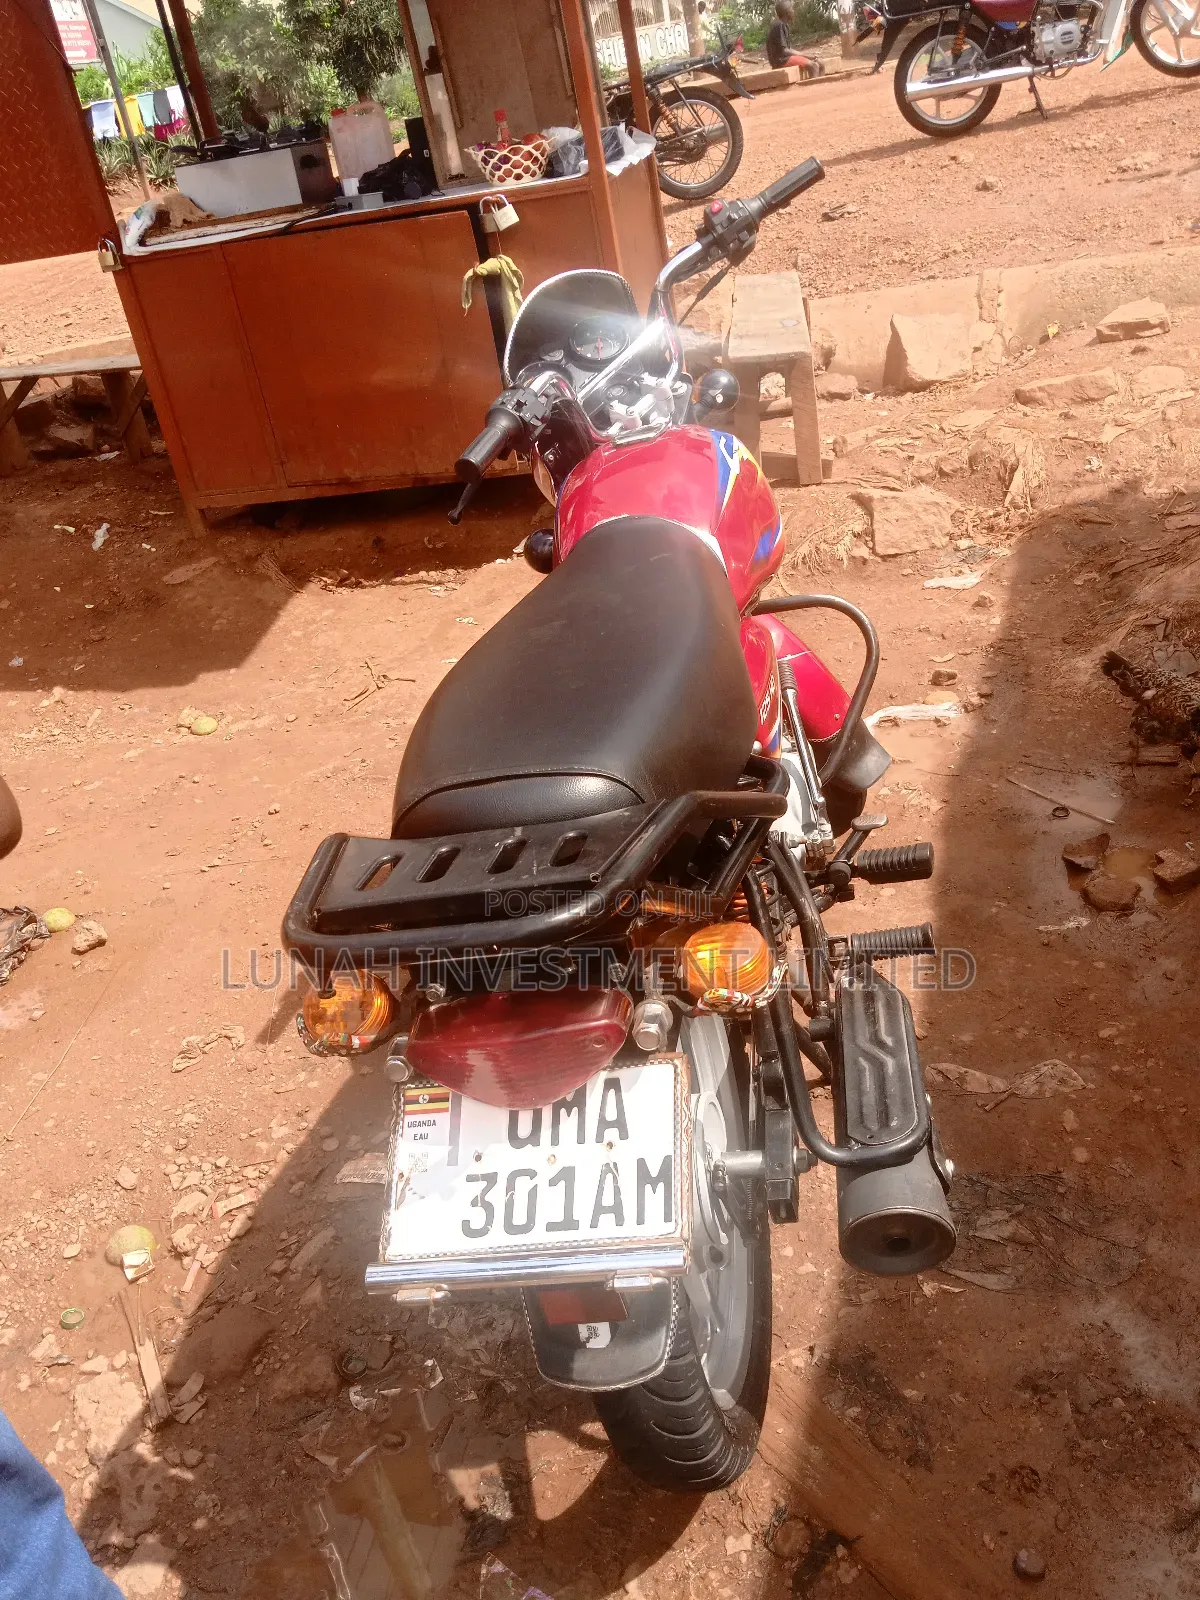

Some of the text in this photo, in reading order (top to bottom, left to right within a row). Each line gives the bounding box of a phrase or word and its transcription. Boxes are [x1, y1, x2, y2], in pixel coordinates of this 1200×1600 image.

[407, 1119, 437, 1129] UGANDA
[413, 1132, 429, 1141] EAU
[461, 1154, 673, 1239] 301AM
